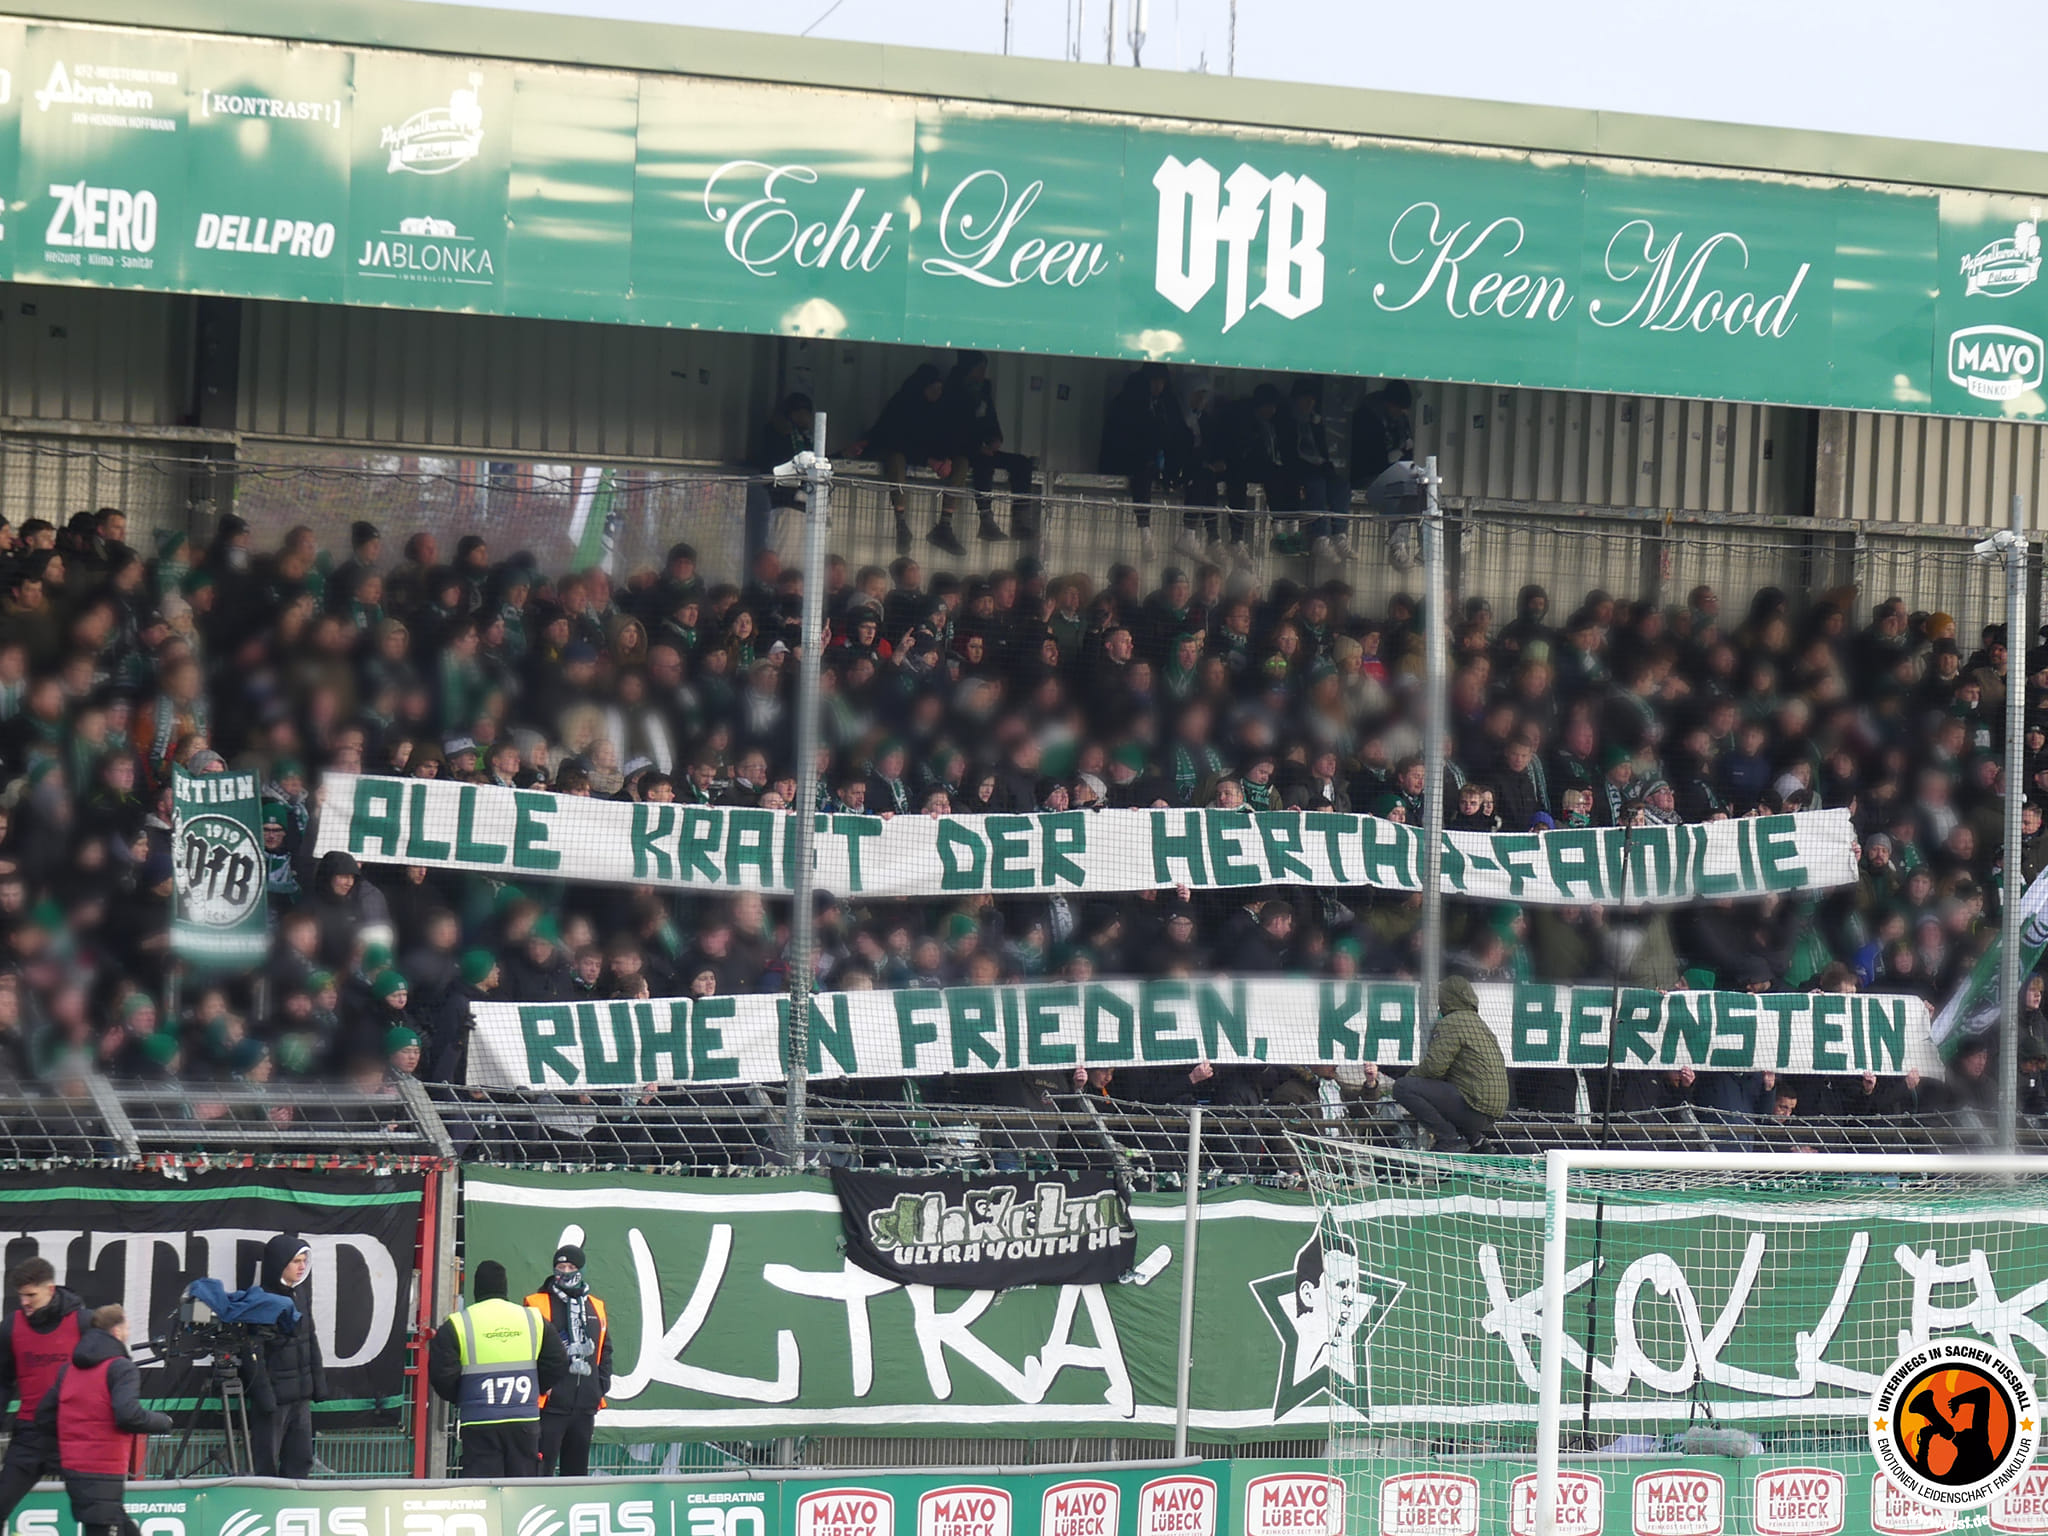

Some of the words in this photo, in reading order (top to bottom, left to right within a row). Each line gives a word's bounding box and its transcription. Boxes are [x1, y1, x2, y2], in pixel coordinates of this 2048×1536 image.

[195, 212, 335, 259] DELLPRO
[45, 251, 82, 267] Heizung
[88, 253, 114, 267] Klima
[358, 240, 494, 275] JABLONKA
[704, 160, 893, 276] Echt
[1373, 201, 1575, 322] Keen
[1589, 219, 1811, 338] Mood
[1958, 341, 2035, 375] MAYO
[349, 779, 561, 869] ALLE
[631, 802, 882, 892] KRAFT
[937, 811, 1086, 890] DER
[518, 998, 740, 1086] RUHE
[777, 994, 857, 1075] IN
[893, 980, 1268, 1069] FRIEDEN,
[1318, 981, 1425, 1061] KA
[1512, 984, 1906, 1072] BERNSTEIN
[481, 1375, 532, 1405] 179
[687, 1492, 765, 1504] CELEBRATING
[1153, 1487, 1204, 1512] MAYO
[1262, 1485, 1328, 1507] MAYO
[1397, 1484, 1463, 1506] MAYO
[1648, 1481, 1709, 1502] MAYO
[1769, 1479, 1830, 1500] MAYO
[123, 1503, 186, 1514] EBRATING
[813, 1501, 878, 1525] MAYO
[934, 1498, 996, 1522] MAYO
[1055, 1493, 1107, 1517] MAYO
[1526, 1507, 1587, 1524] LECK
[1648, 1505, 1708, 1522] LÜBECK
[1769, 1502, 1829, 1519] LÜBECK
[1151, 1512, 1202, 1531] LÜBECK
[1262, 1508, 1328, 1527] LÜBECK
